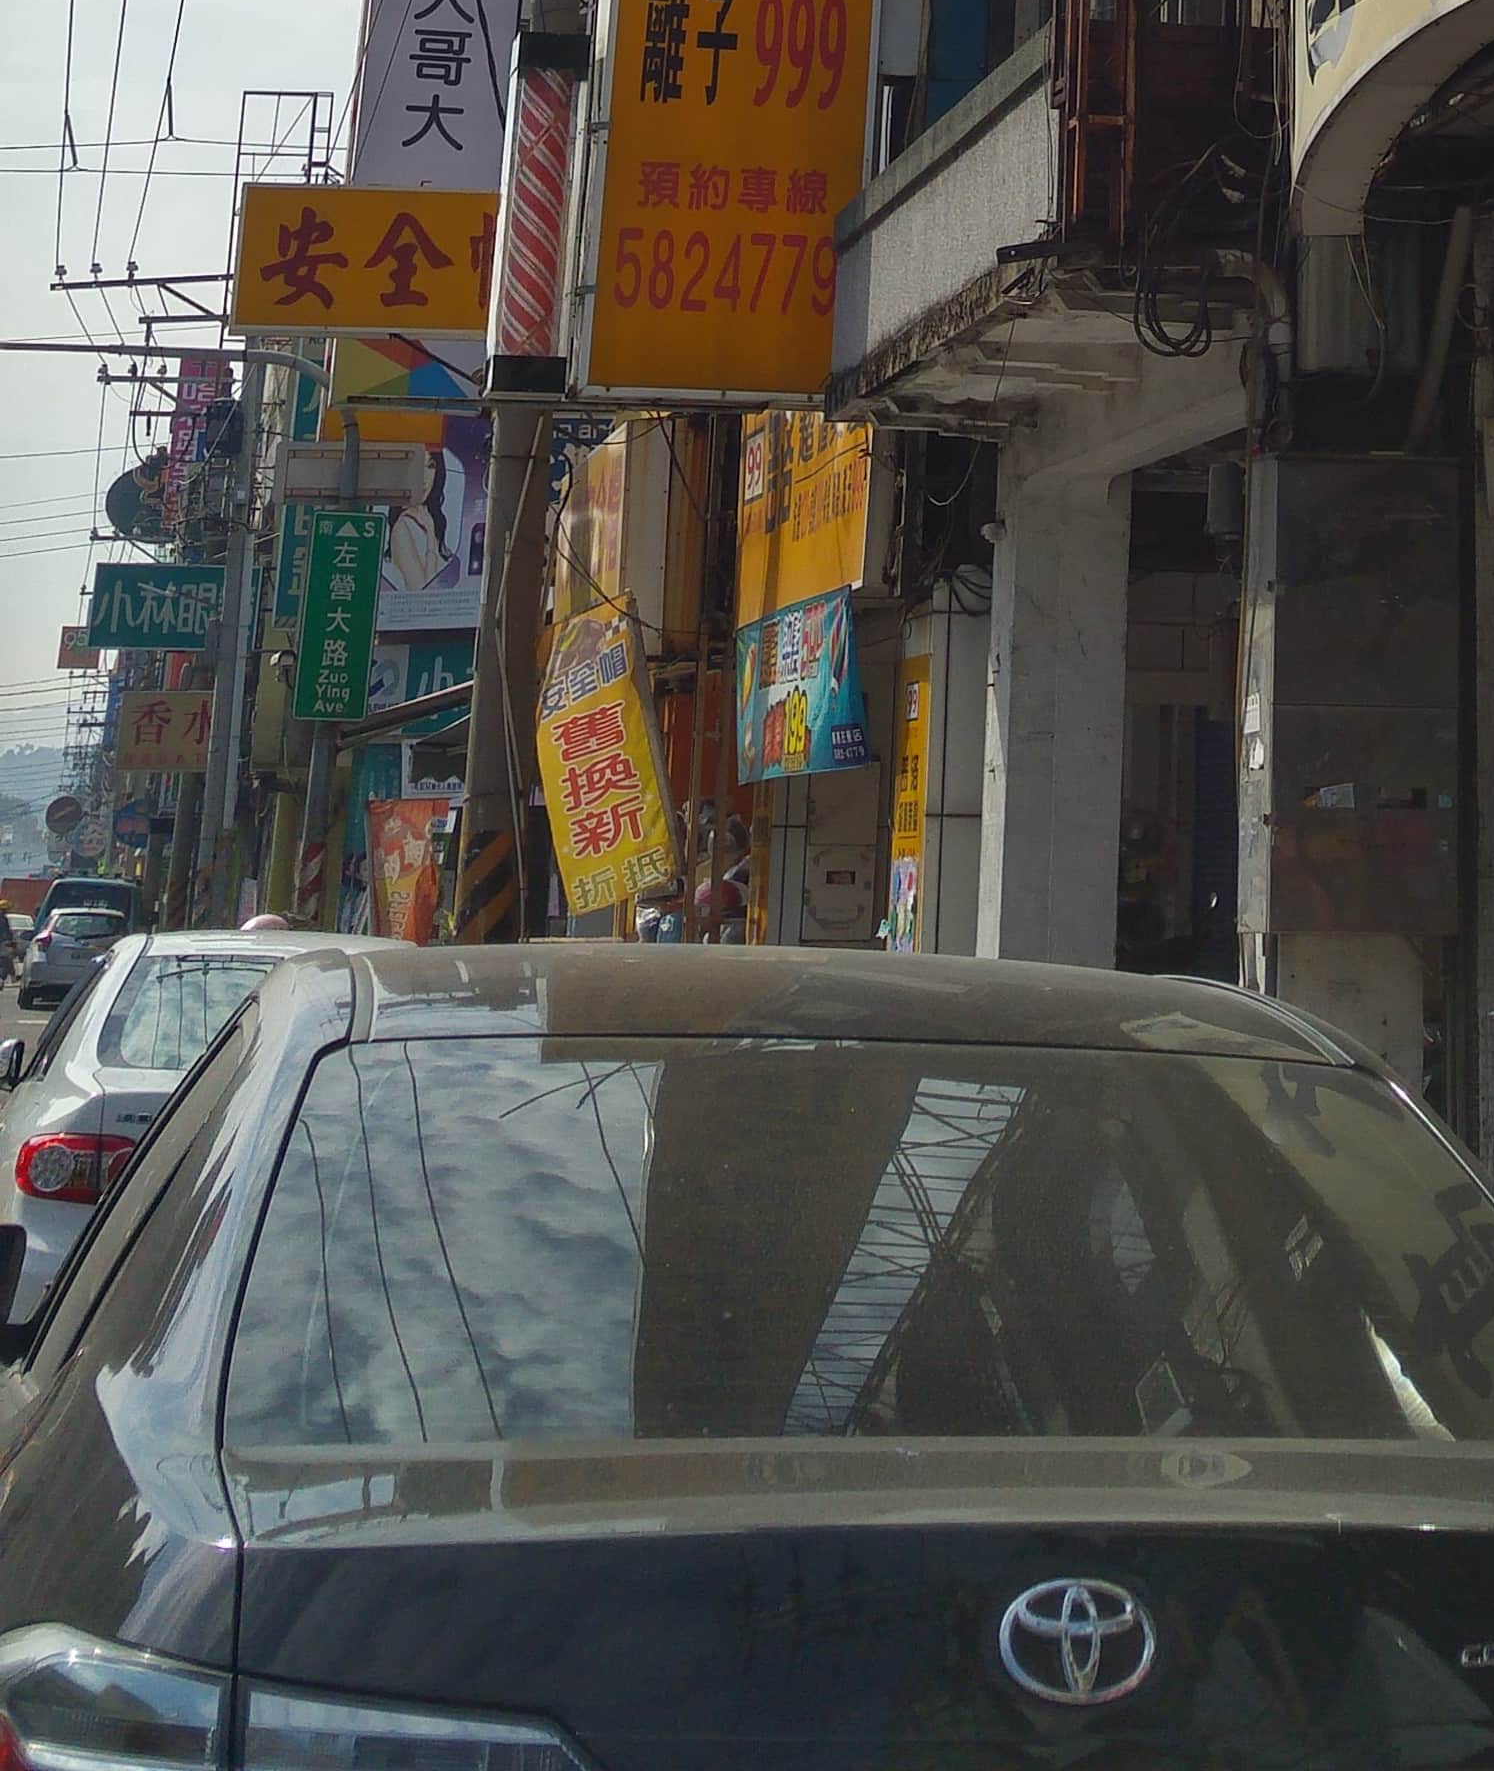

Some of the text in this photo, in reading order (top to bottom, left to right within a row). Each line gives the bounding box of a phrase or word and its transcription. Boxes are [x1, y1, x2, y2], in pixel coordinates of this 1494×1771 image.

[637, 161, 829, 216] 預約專線
[258, 205, 490, 312] 安全
[612, 227, 838, 319] 5824779
[92, 577, 222, 640] 小林眼
[321, 541, 358, 667] 左營大路
[314, 685, 351, 704] Ying
[317, 669, 349, 685] Zuo
[541, 641, 628, 721] 安全帽
[560, 699, 652, 857] 舊換新
